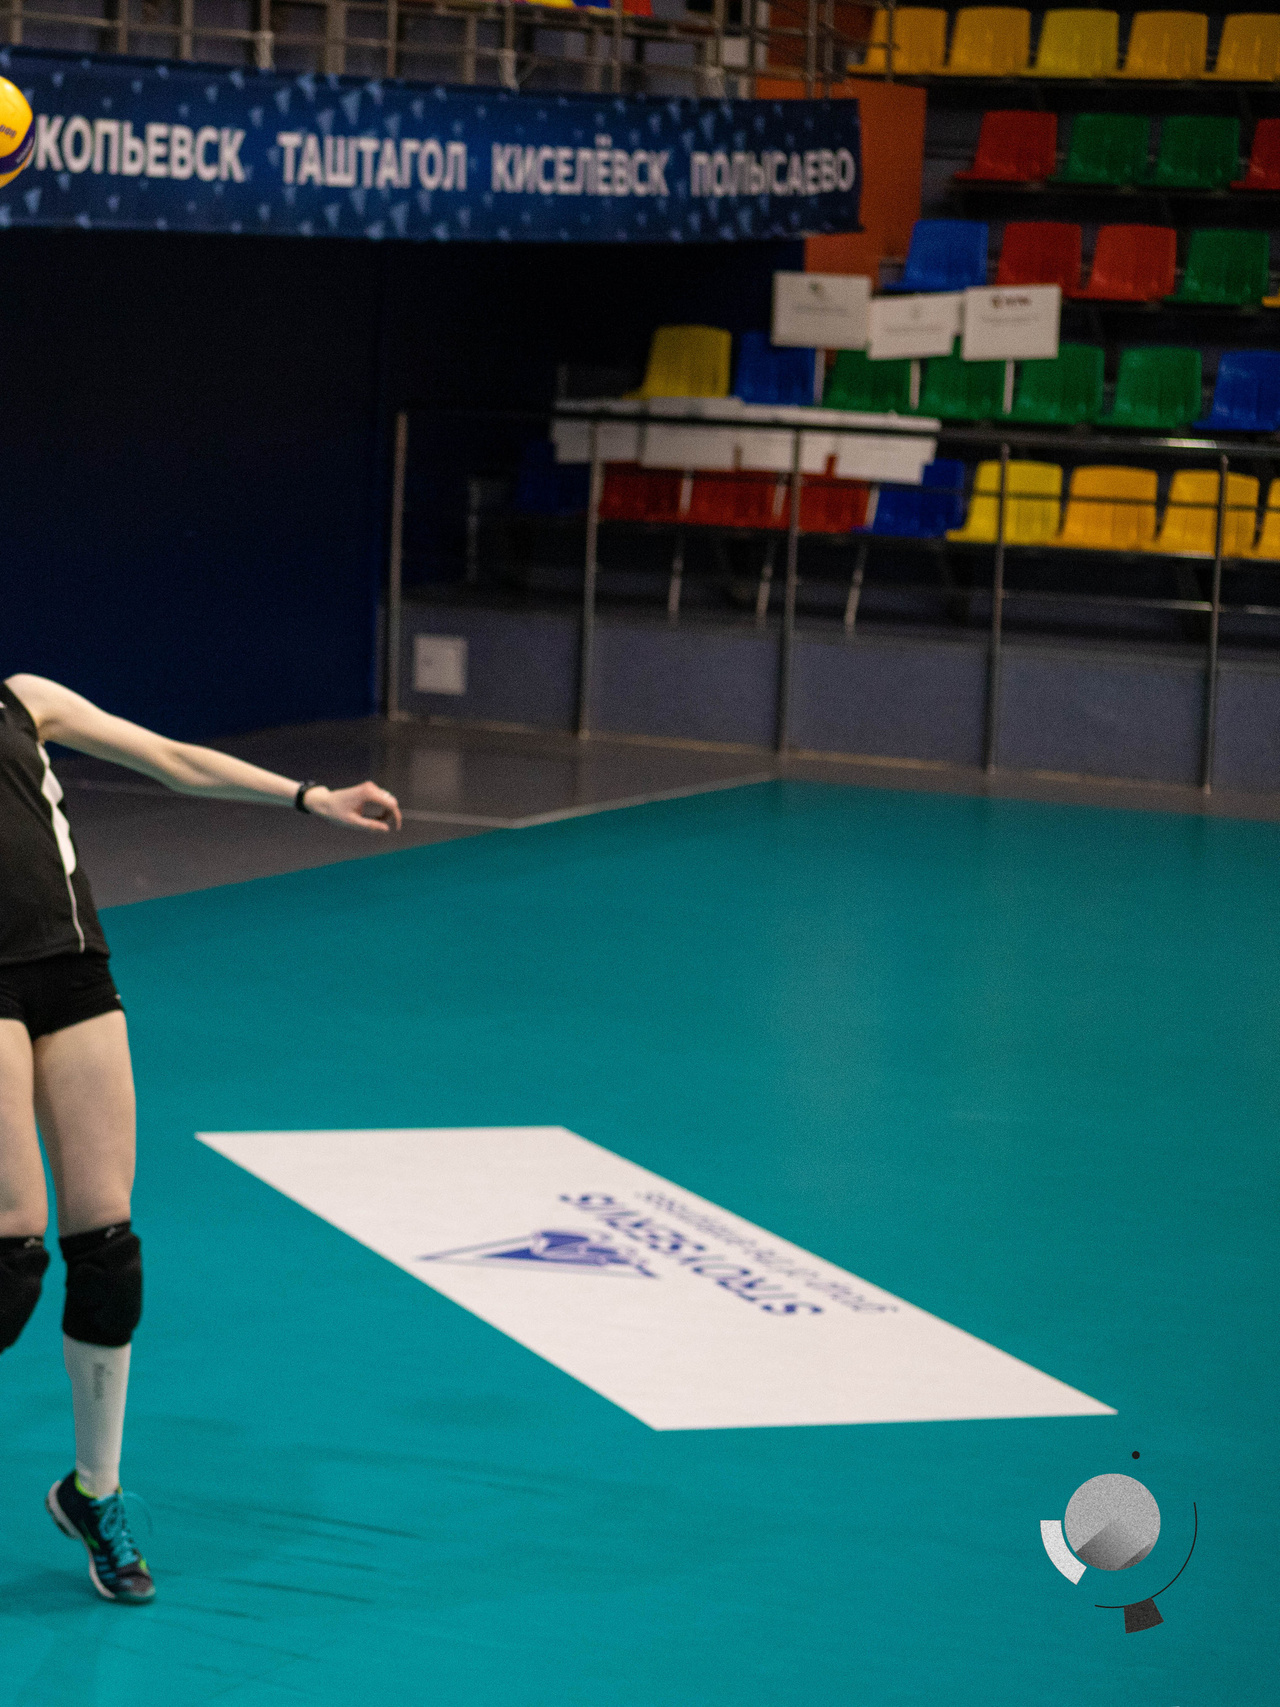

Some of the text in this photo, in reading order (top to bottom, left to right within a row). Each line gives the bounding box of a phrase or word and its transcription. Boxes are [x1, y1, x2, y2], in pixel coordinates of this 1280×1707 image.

[23, 114, 246, 183] КОПЬЕВСК
[277, 131, 467, 192] ТАШТАГОЛ
[491, 135, 670, 197] КИСЕЛЁВСК
[690, 148, 856, 197] ПОЛЫСАЕВО
[559, 1193, 823, 1315] STROYSERVIS
